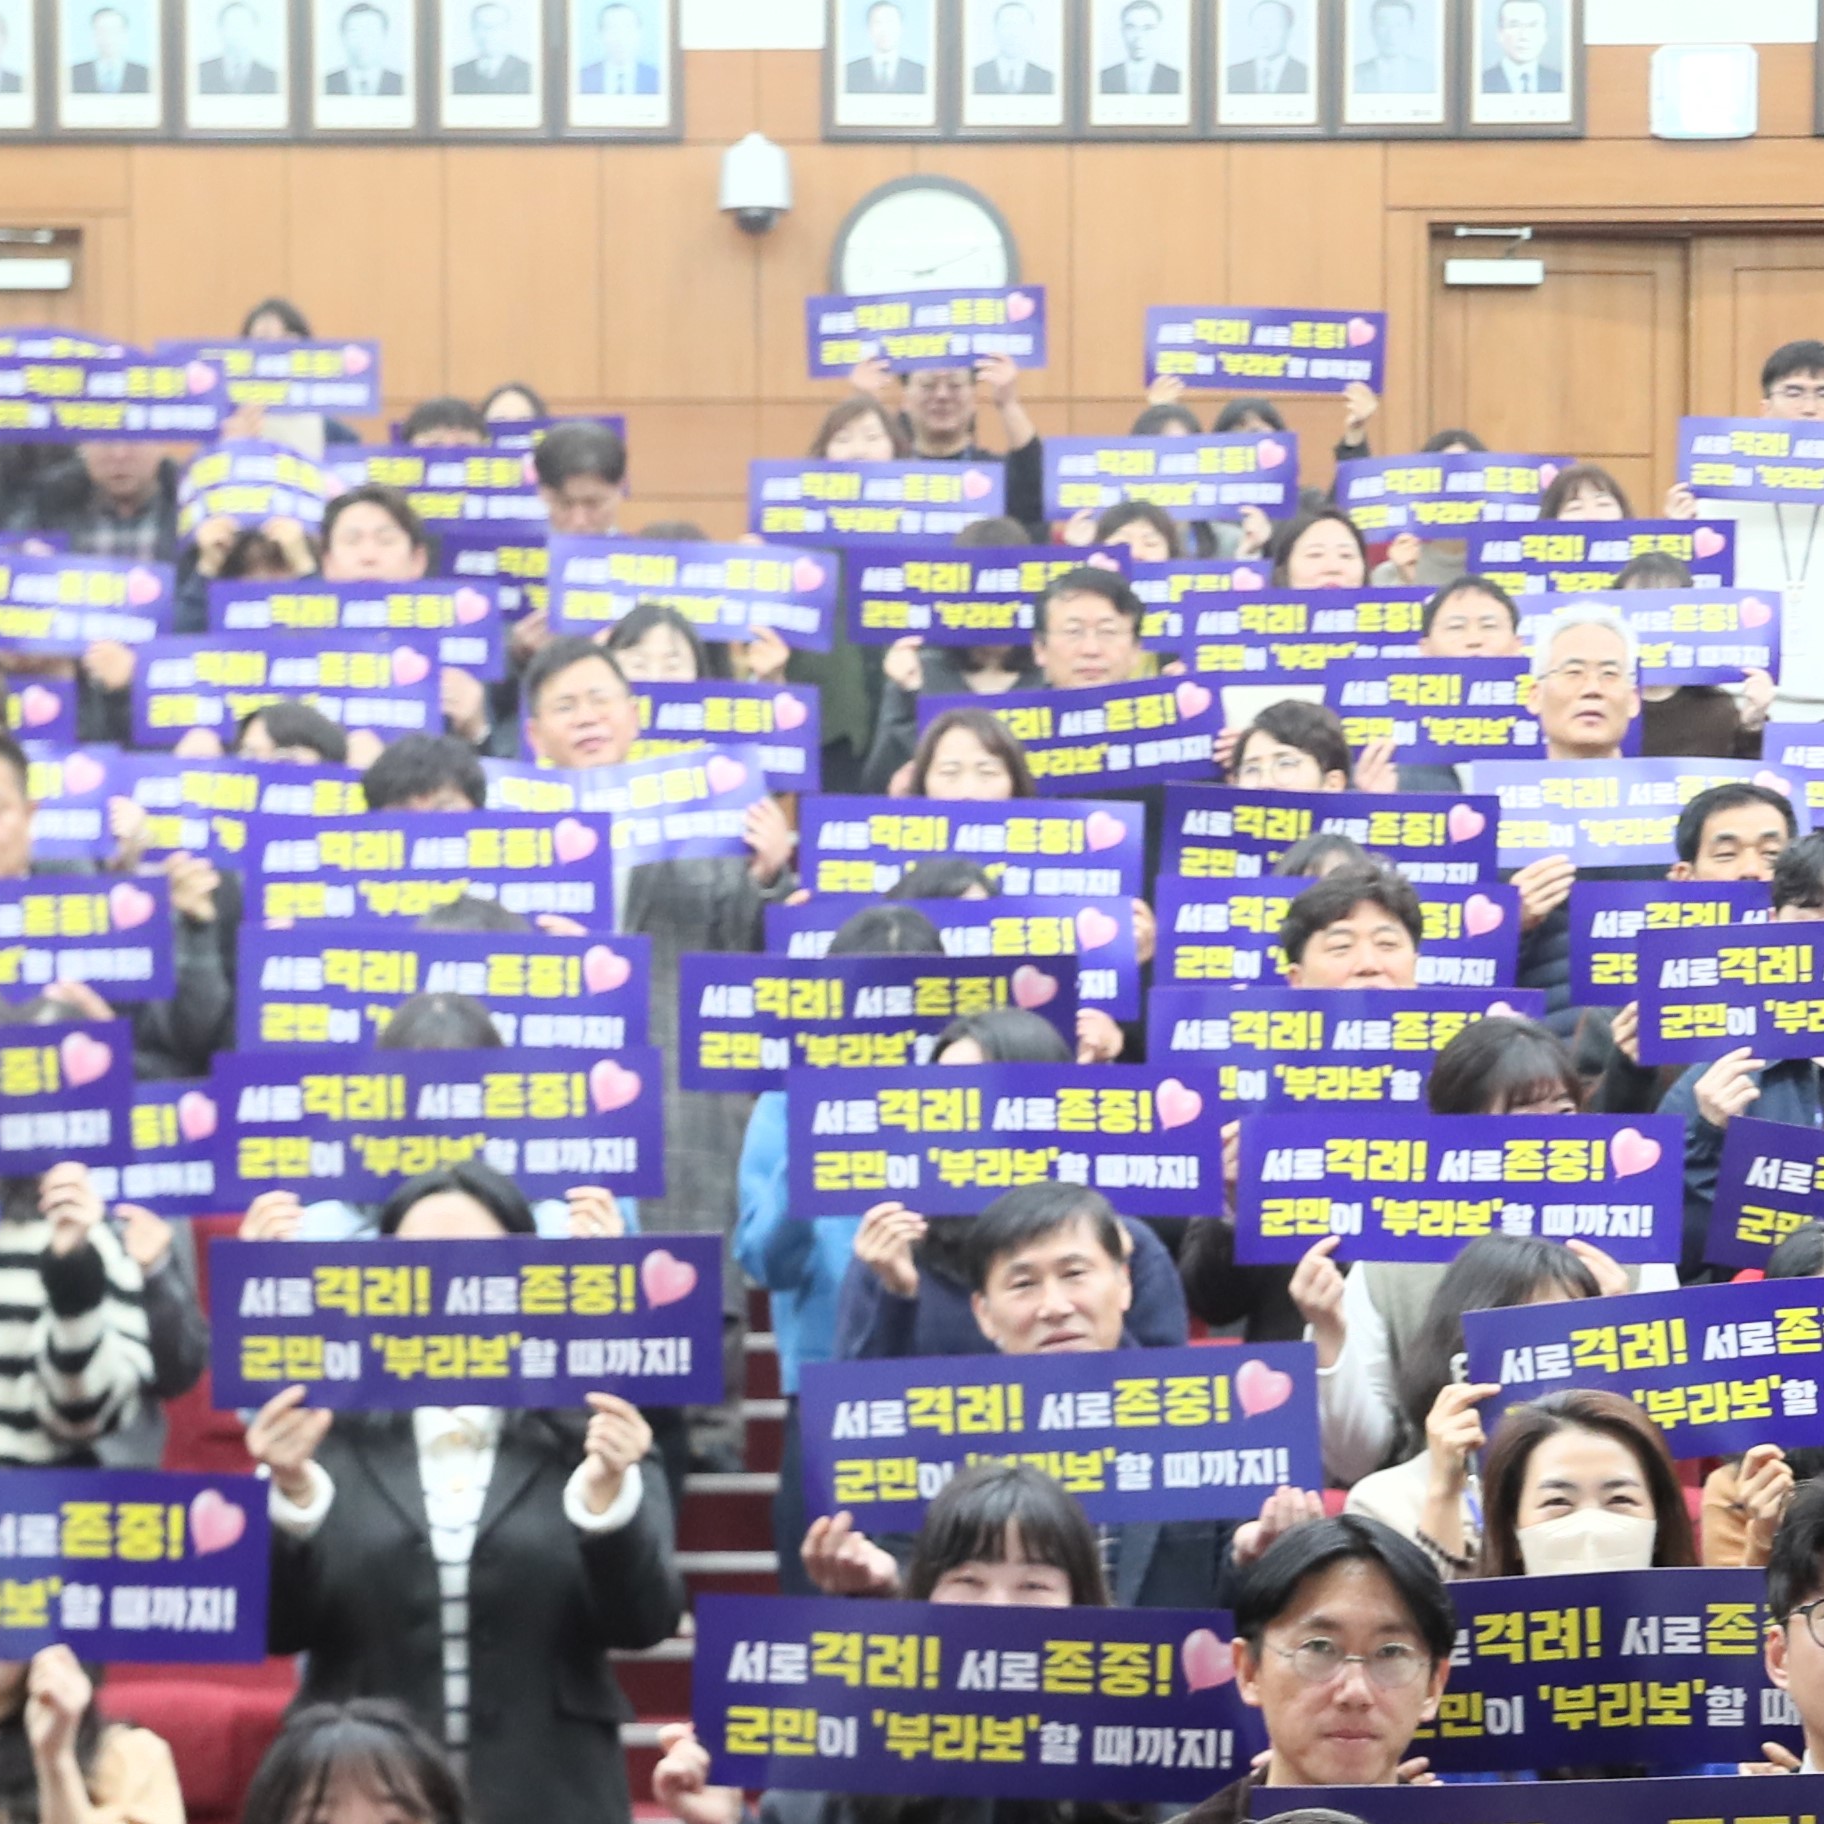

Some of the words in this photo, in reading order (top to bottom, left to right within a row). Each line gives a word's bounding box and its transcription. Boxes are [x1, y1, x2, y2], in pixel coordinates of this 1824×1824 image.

[1659, 944, 1811, 988] 서로격려!
[1660, 1002, 1756, 1039] 군민이
[237, 1075, 404, 1120] 서로격려!
[418, 1072, 585, 1118] 서로존중!
[812, 1088, 979, 1132] 서로격려!
[993, 1090, 1151, 1132] 서로존중!
[238, 1138, 343, 1177] 군민이
[526, 1138, 635, 1172] 때까지!
[813, 1150, 919, 1190] 군민이
[929, 1148, 1088, 1188] '부라보'할
[1096, 1153, 1198, 1186] 때까지!
[1261, 1139, 1426, 1181] 서로격려!
[1438, 1140, 1605, 1182] 서로존중!
[1259, 1198, 1362, 1235] 군민이
[1373, 1197, 1534, 1236] '부라보'할
[1542, 1204, 1651, 1237] 때까지!
[239, 1266, 429, 1316] 서로격려!
[445, 1265, 634, 1314] 서로존중!
[241, 1336, 360, 1380] 군민이
[372, 1332, 557, 1378] '부라보'할
[568, 1338, 690, 1375] 때까지!
[1498, 1319, 1689, 1385] 서로격려!
[831, 1383, 1024, 1440] 서로격려!
[1038, 1374, 1231, 1430] 서로존중!
[1631, 1375, 1818, 1430] '부라보'할
[833, 1456, 954, 1503] 군민이
[1163, 1447, 1290, 1488] 때까지!
[109, 1587, 238, 1626] 때까지!
[1620, 1603, 1776, 1656] 서로존
[726, 1631, 940, 1689] 서로격려!
[957, 1640, 1170, 1696] 서로존중!
[1538, 1678, 1747, 1731] '부라보'할
[724, 1706, 858, 1757] 군민이
[873, 1708, 1081, 1764] '부라보'할
[1092, 1725, 1231, 1770] 때까지!
